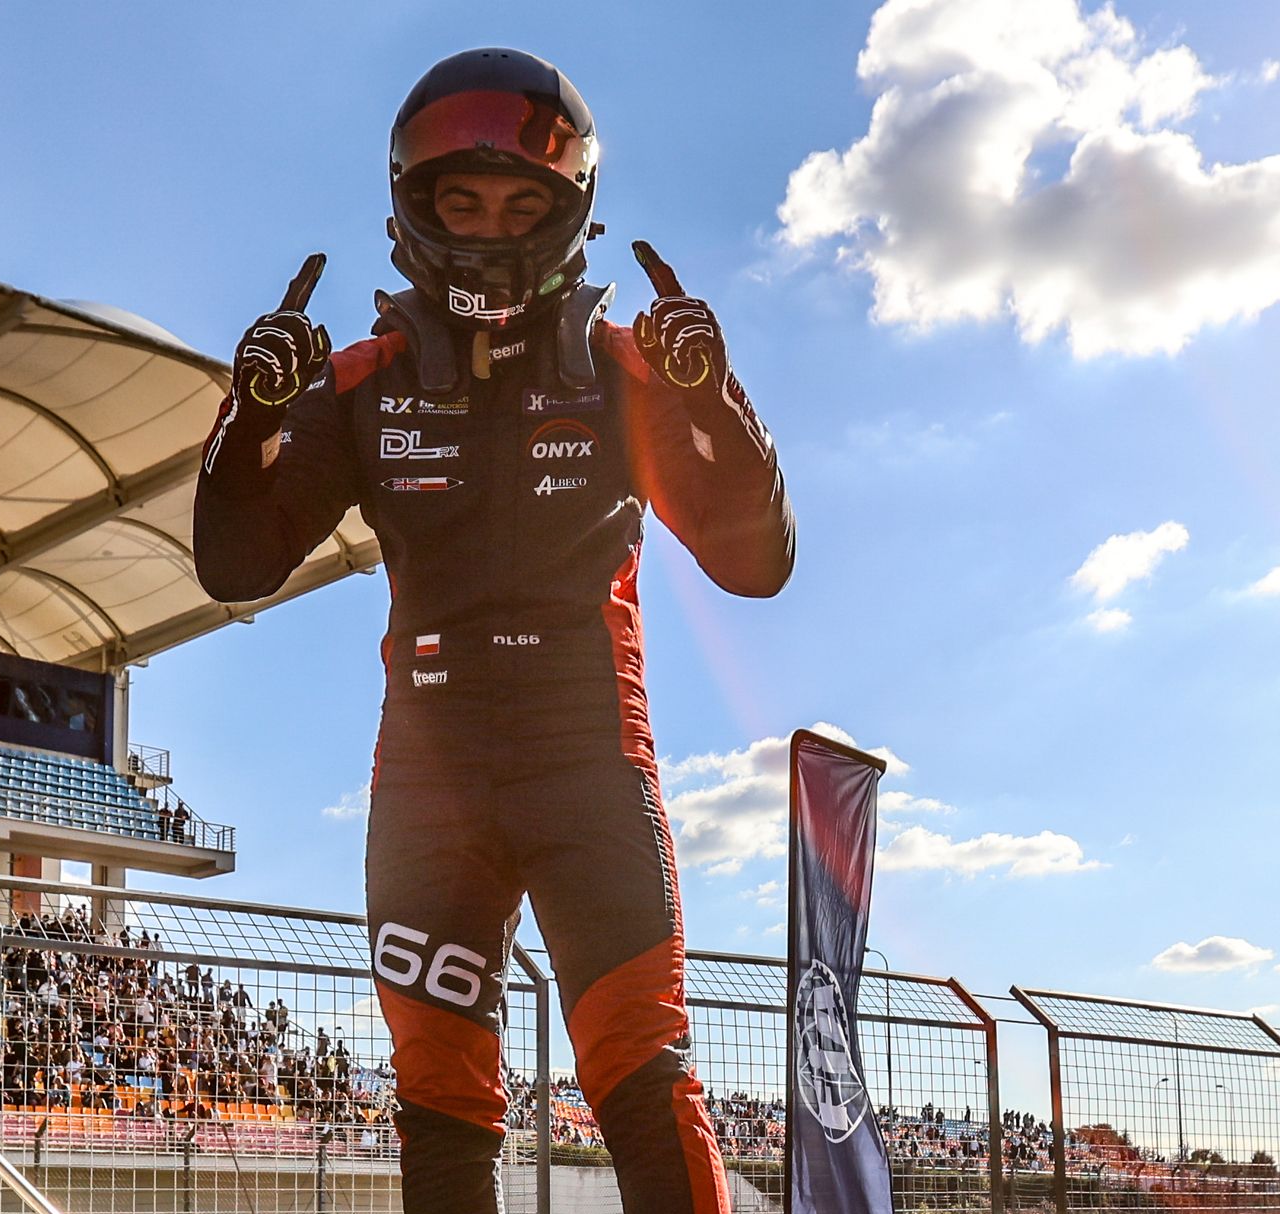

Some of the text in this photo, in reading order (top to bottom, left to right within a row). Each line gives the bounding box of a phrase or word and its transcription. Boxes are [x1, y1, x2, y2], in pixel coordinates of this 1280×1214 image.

[380, 396, 414, 413] RX
[532, 441, 593, 459] ONYX
[534, 475, 587, 496] ALBECO
[412, 669, 448, 687] freem
[375, 922, 487, 1007] 66
